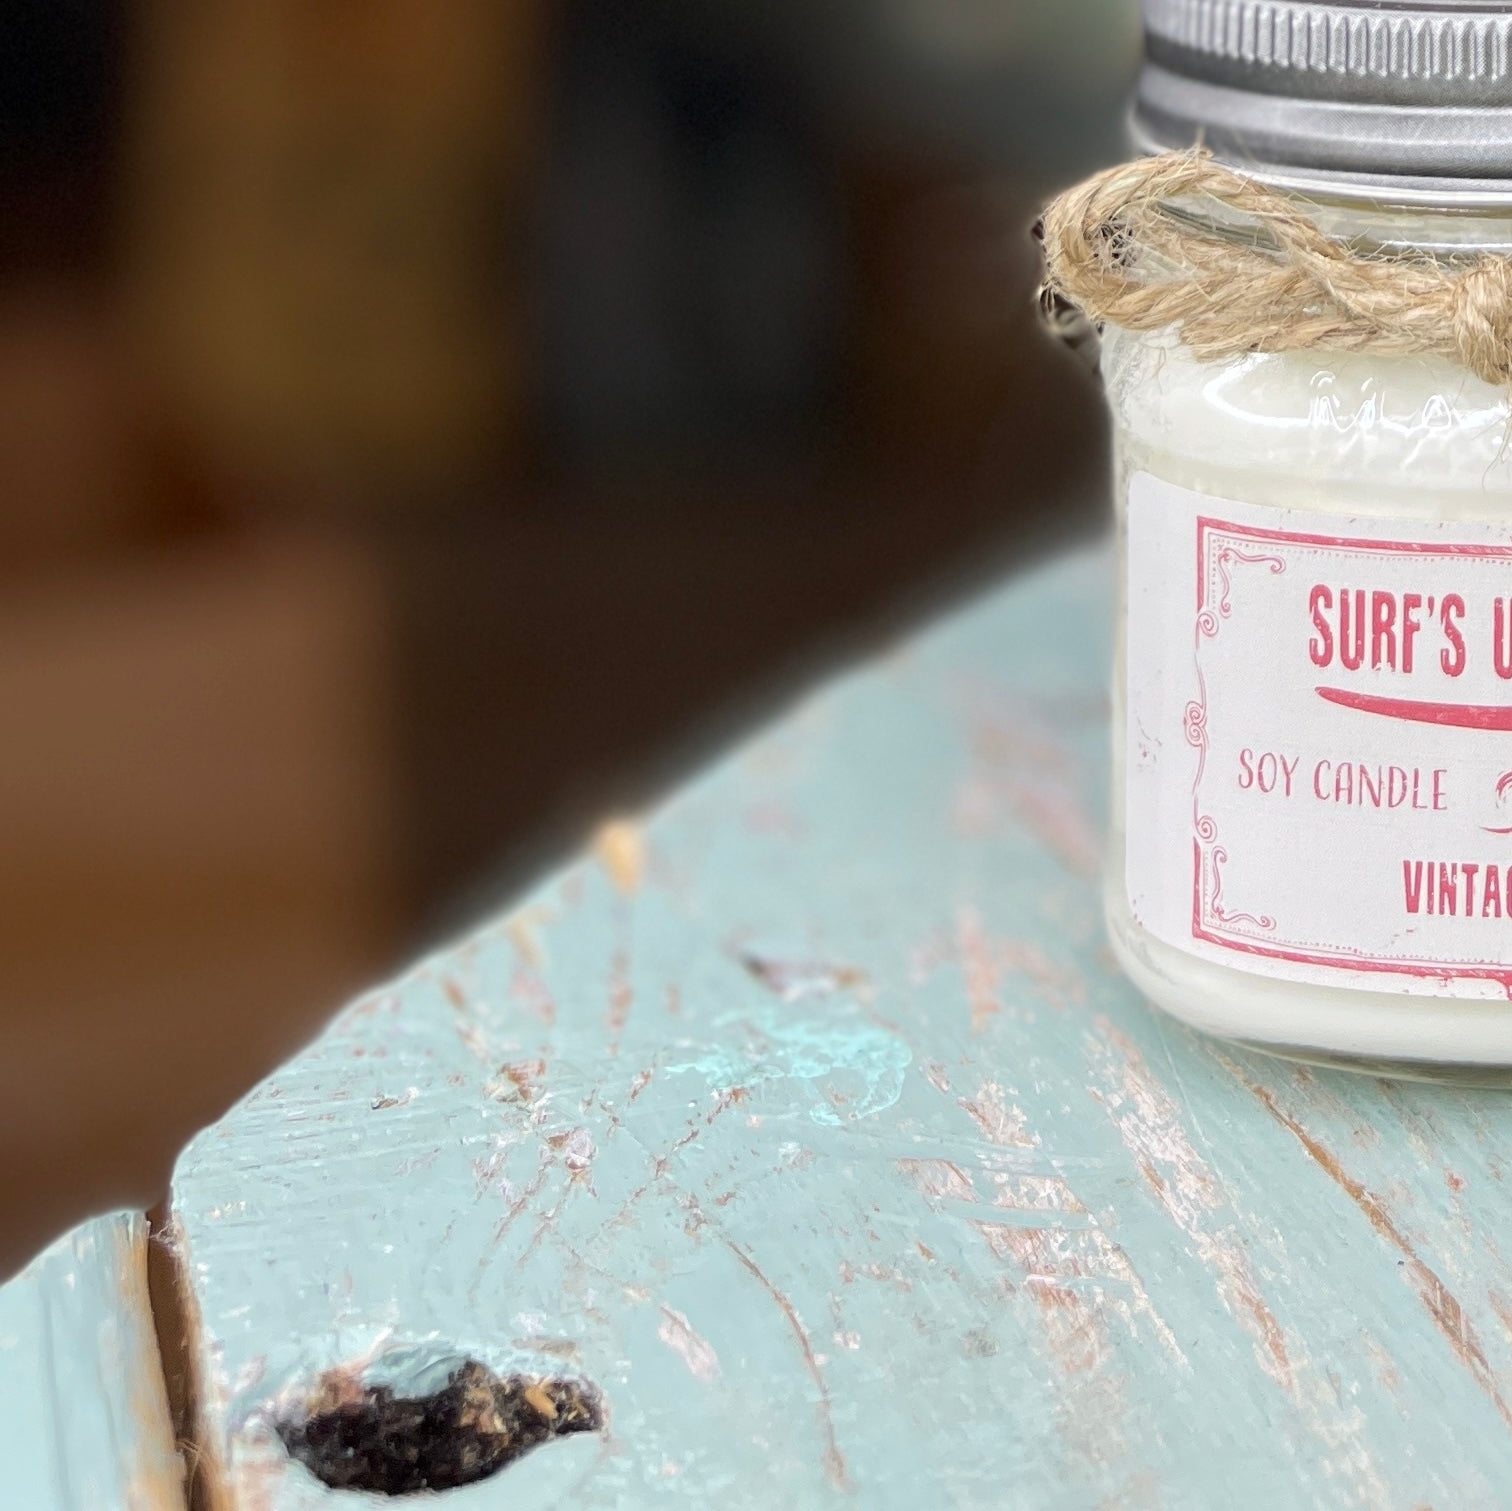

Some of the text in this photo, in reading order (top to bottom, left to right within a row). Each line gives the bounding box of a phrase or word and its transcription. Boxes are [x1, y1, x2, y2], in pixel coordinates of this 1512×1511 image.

[1308, 584, 1466, 678] SURF'S
[1238, 748, 1449, 811] SOY CANDLE
